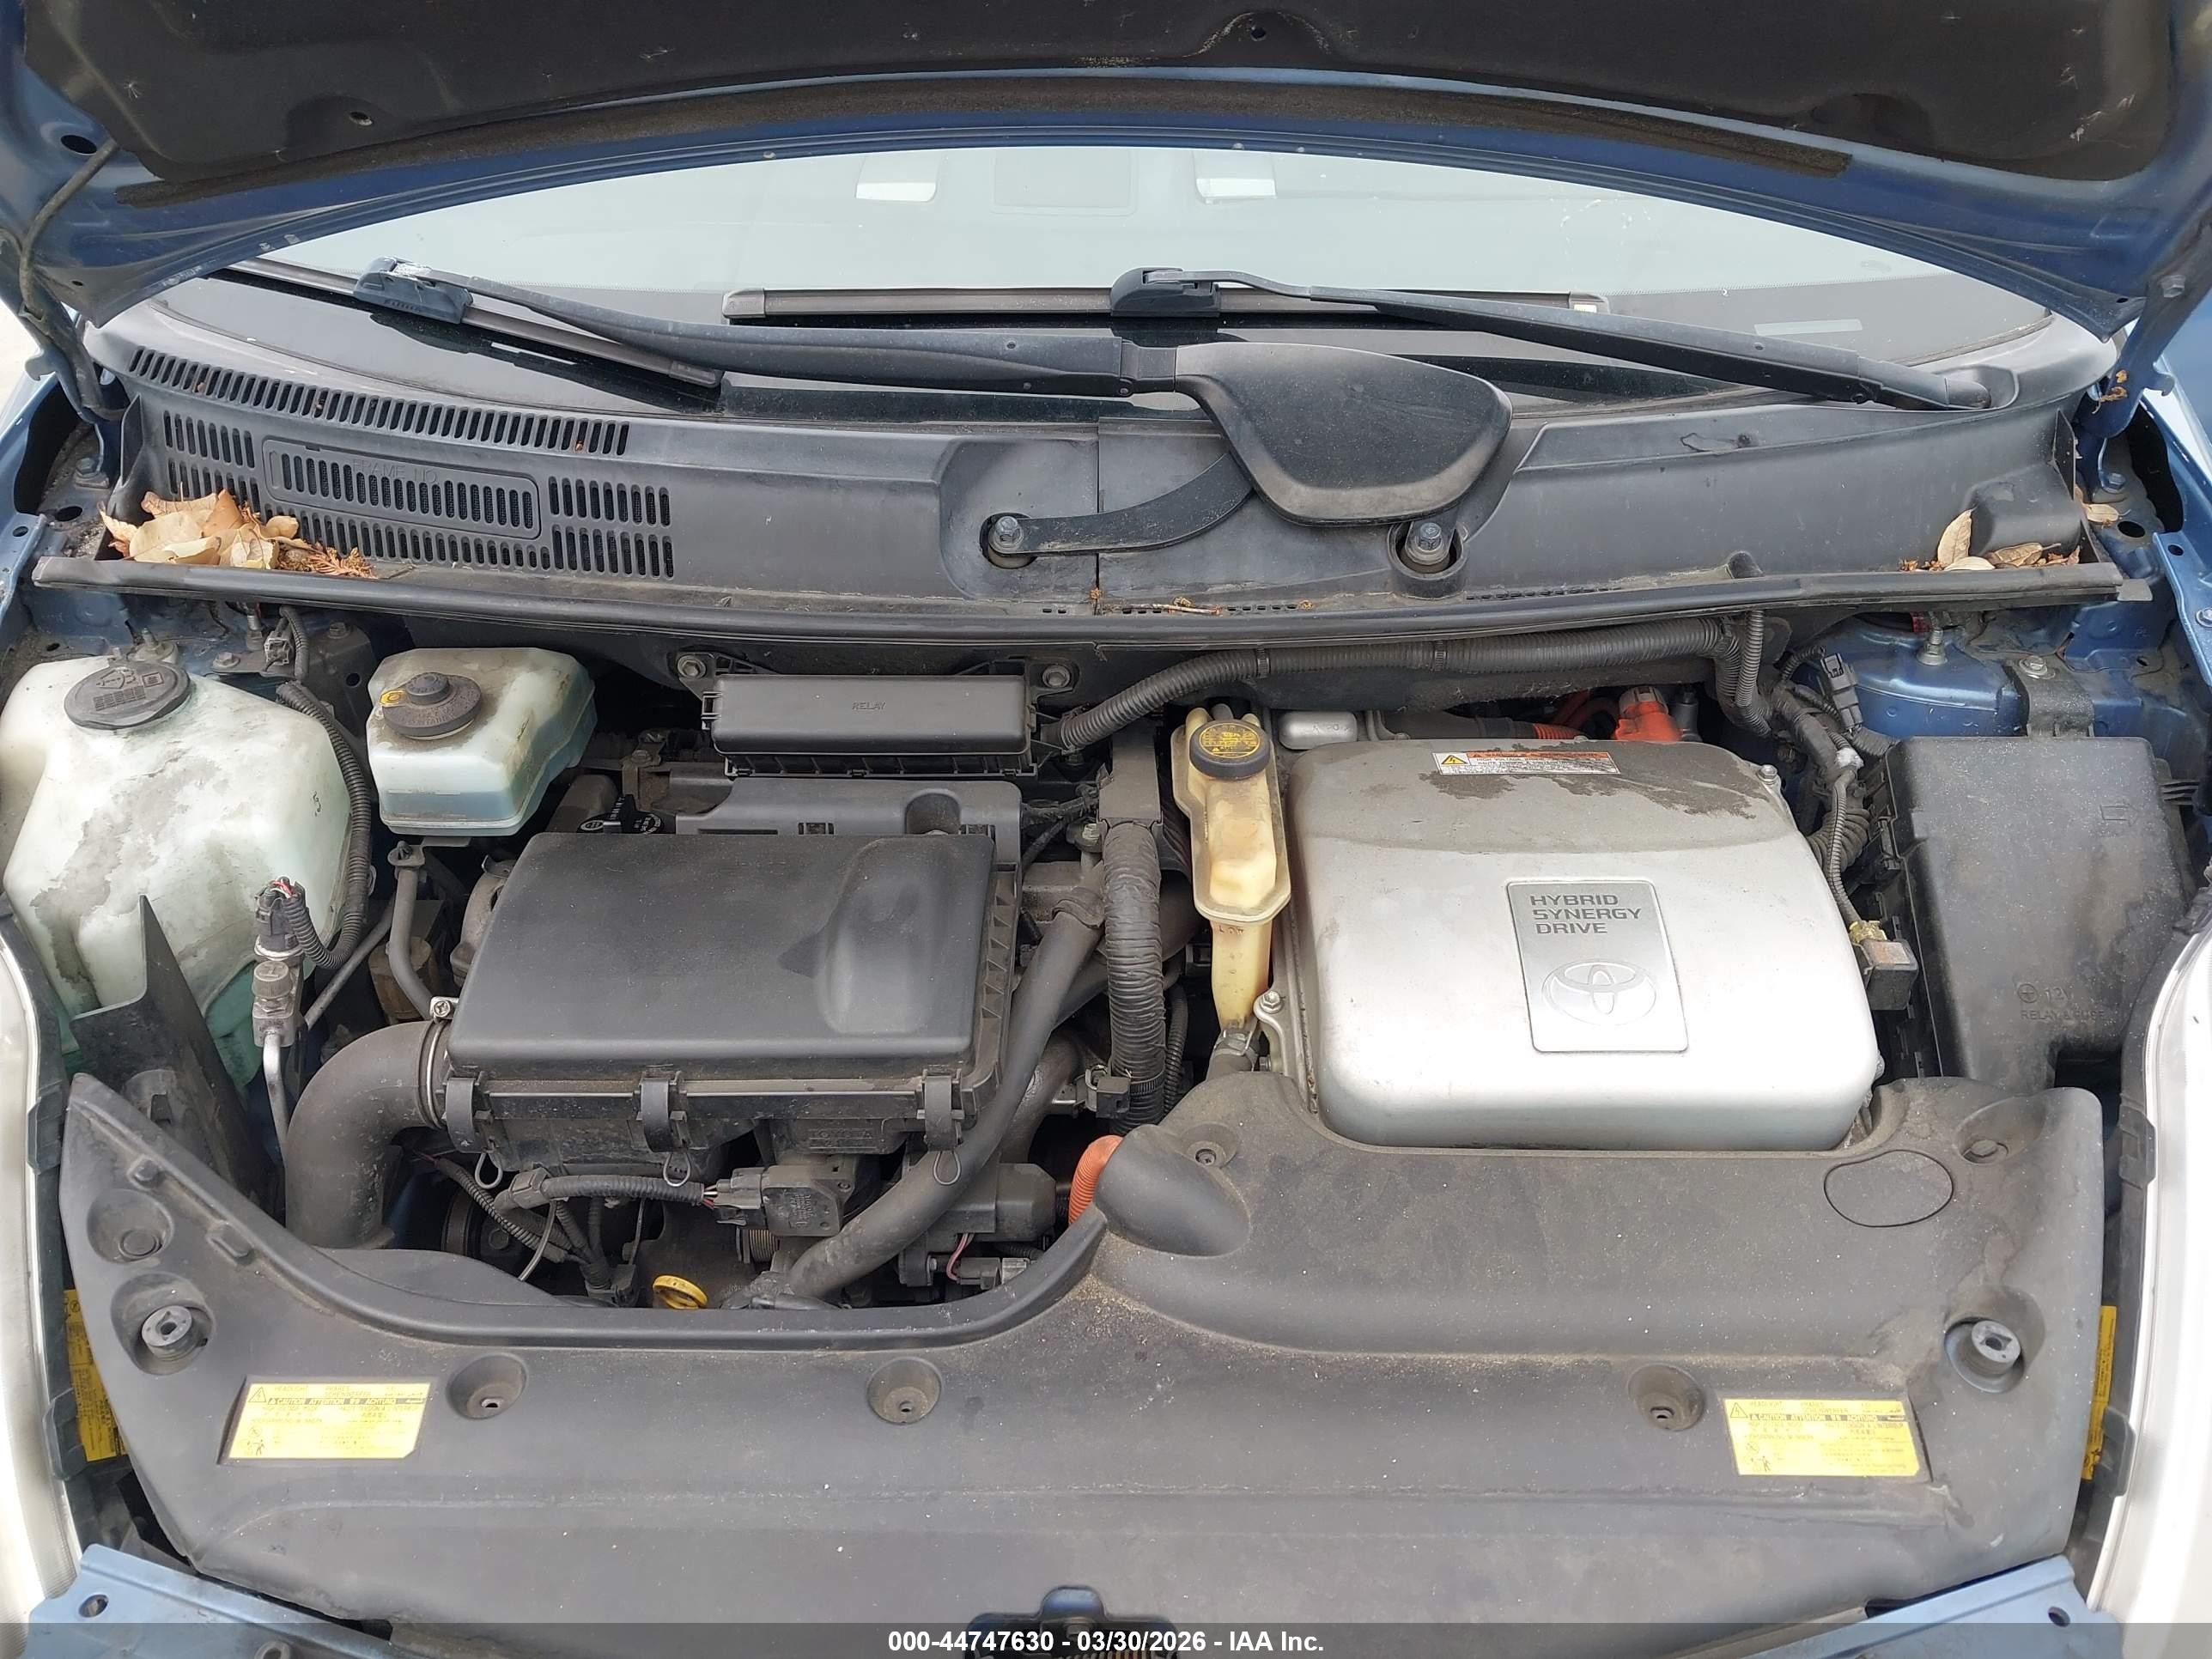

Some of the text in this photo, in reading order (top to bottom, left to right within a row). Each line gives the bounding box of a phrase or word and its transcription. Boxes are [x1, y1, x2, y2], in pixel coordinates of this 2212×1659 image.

[352, 459, 407, 479] FRAME
[851, 701, 886, 711] RELAY
[1529, 894, 1620, 907] HYBRID
[1532, 908, 1642, 921] SYNERGY
[1535, 922, 1609, 934] DRIVE
[2020, 1009, 2057, 1021] RELAY
